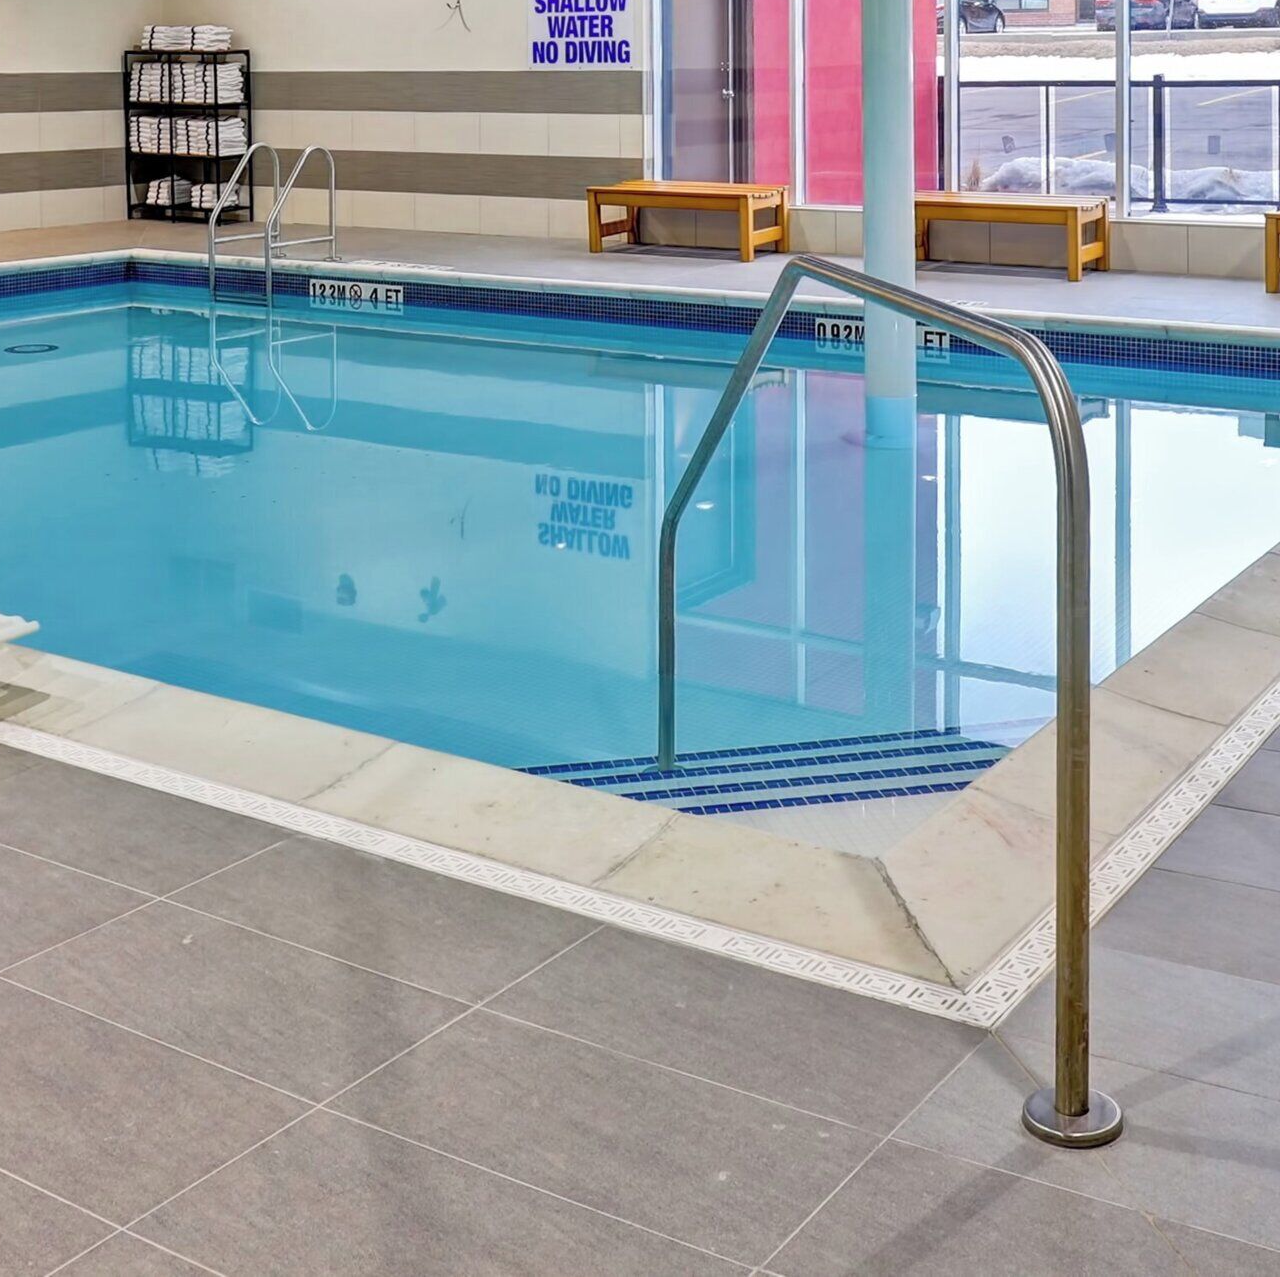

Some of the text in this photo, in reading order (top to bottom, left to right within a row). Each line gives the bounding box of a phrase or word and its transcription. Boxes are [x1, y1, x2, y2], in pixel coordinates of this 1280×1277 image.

[547, 15, 613, 38] WATER
[532, 40, 630, 64] NO DIVING
